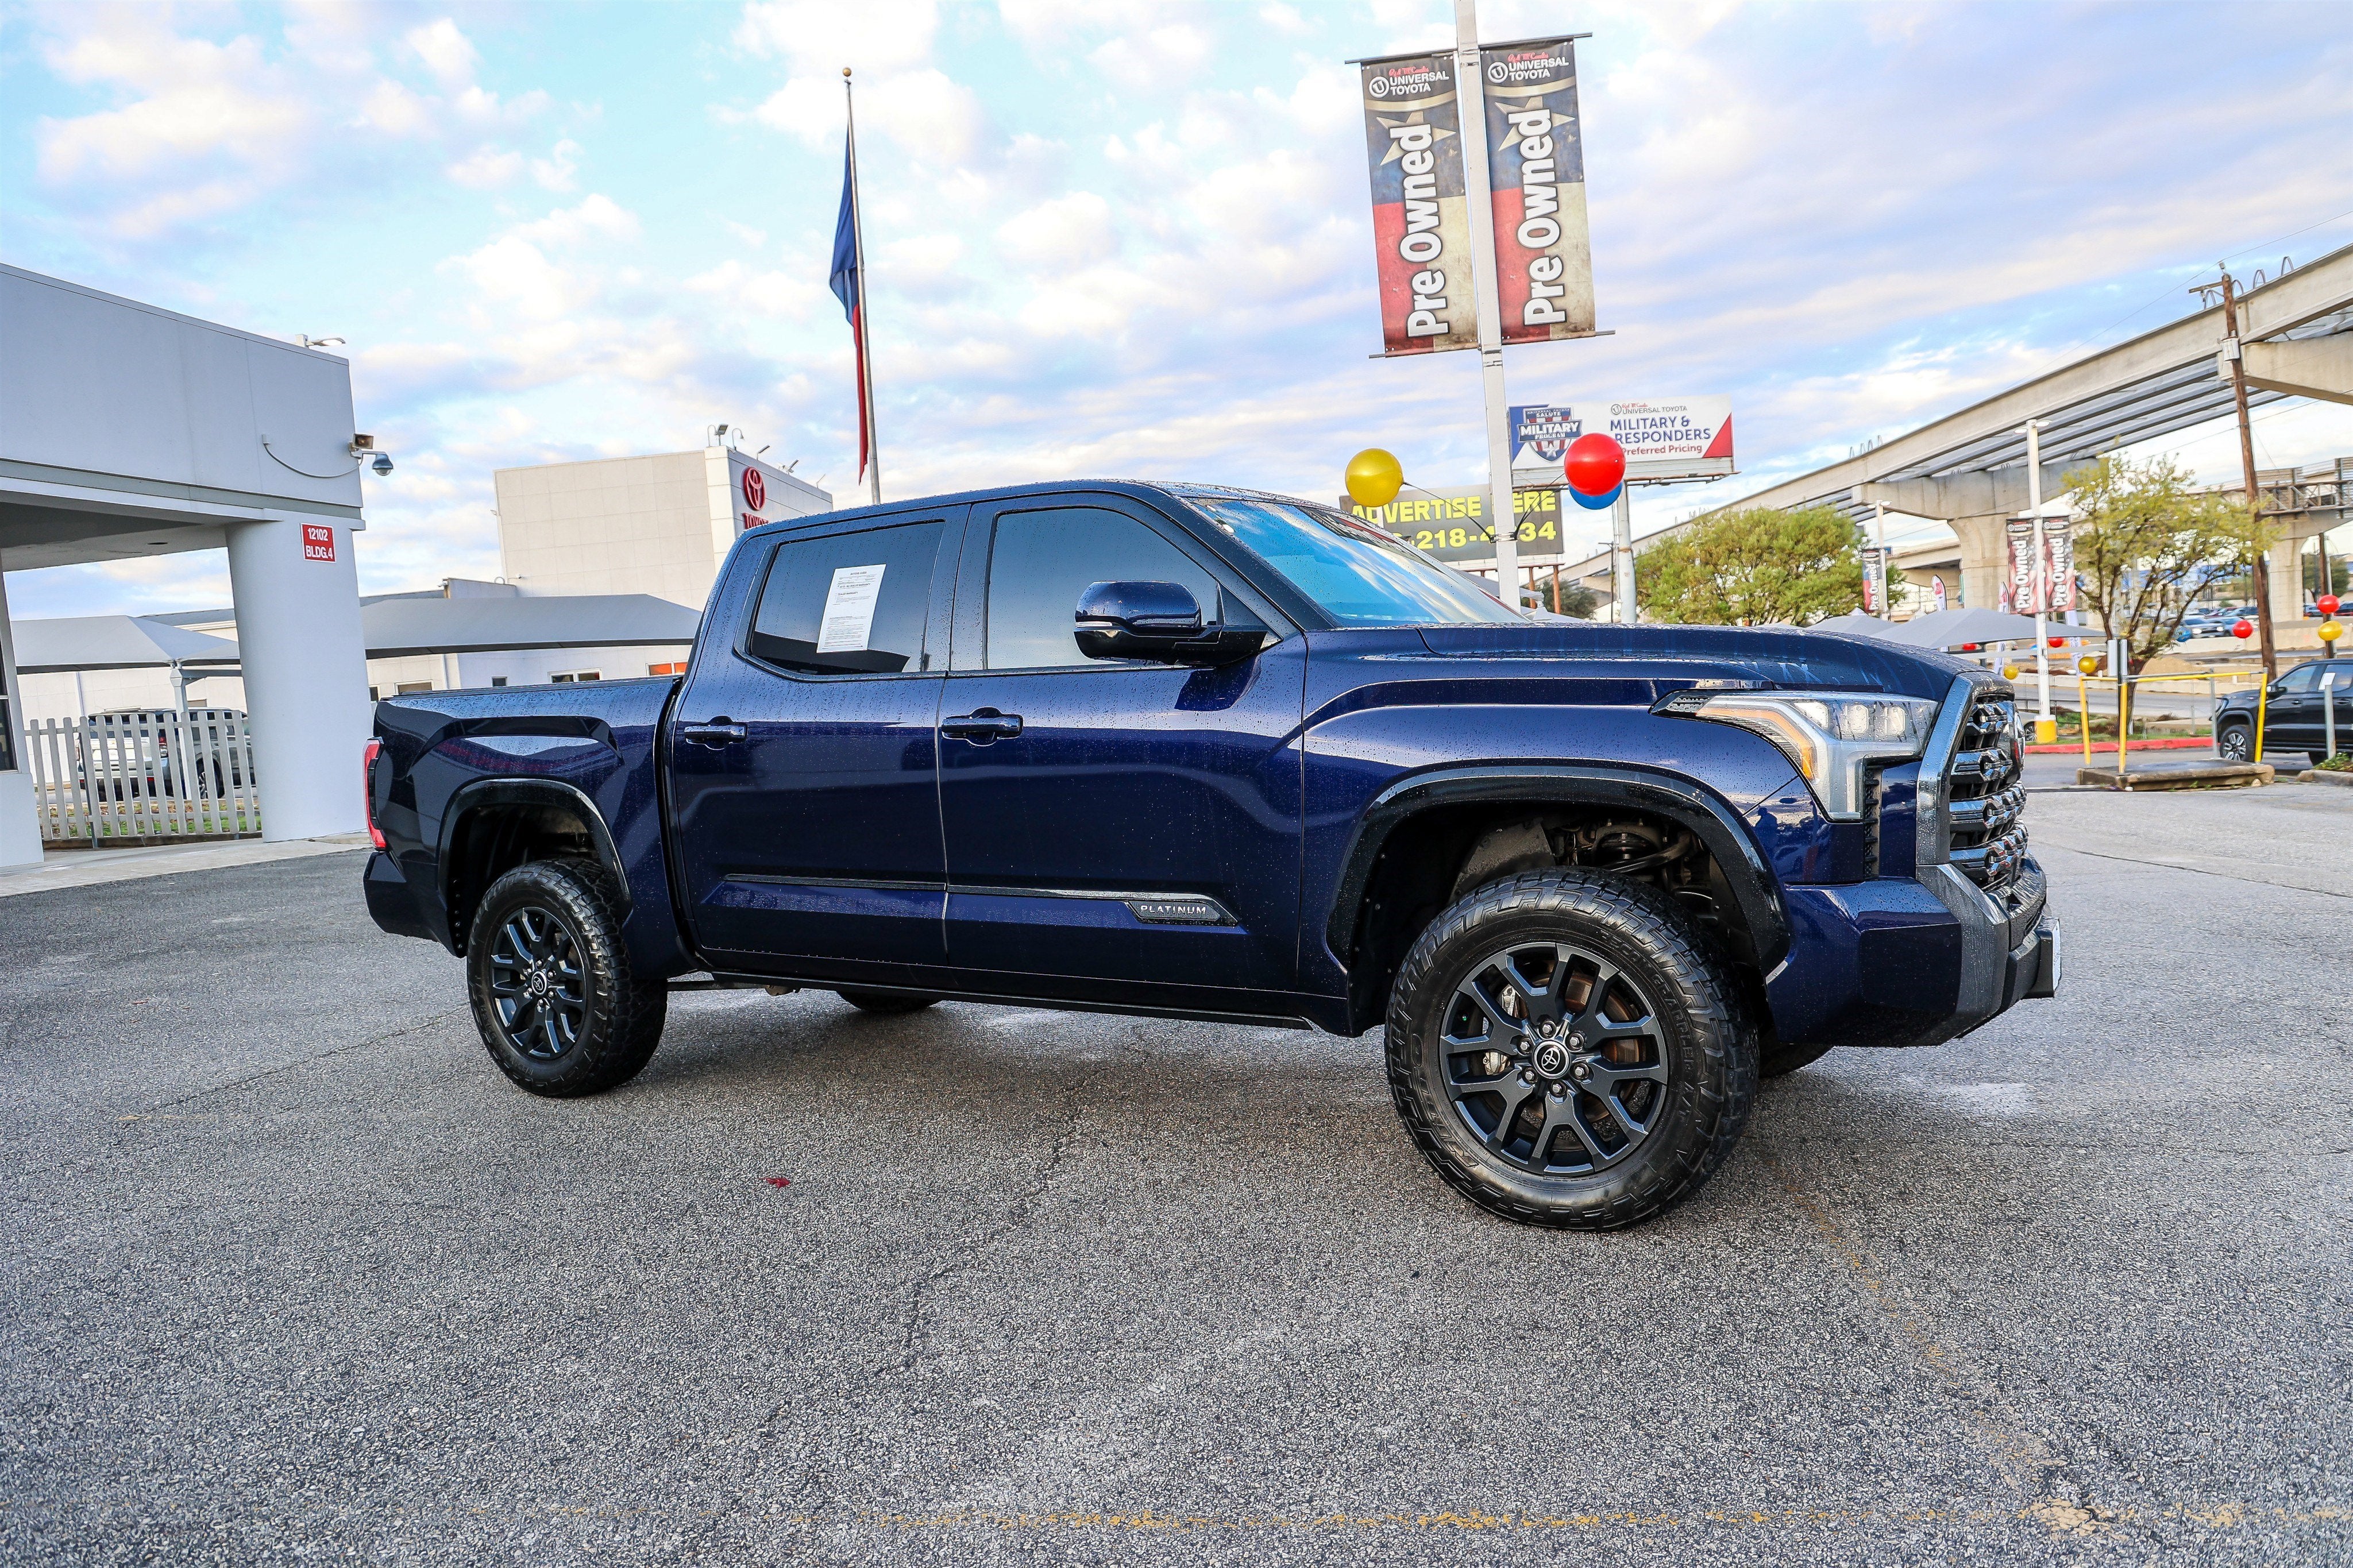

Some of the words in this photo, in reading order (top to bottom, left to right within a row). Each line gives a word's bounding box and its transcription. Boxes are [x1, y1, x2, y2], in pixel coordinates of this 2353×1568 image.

[1509, 56, 1569, 72] UNIVERSAL
[1390, 71, 1449, 86] UNIVERSAL
[1509, 69, 1550, 81] TOYOTA
[1390, 82, 1432, 96] TOYOTA
[1507, 109, 1561, 249] Owned
[1389, 123, 1442, 262] Owned
[1523, 256, 1565, 326] Pre
[1407, 269, 1450, 338] Pre
[1520, 422, 1580, 437] MILITARY
[1610, 415, 1678, 431] MILITARY
[1681, 415, 1691, 427] &
[1615, 428, 1711, 444] RESPONDERS
[1668, 443, 1702, 454] Pricing
[1352, 496, 1482, 524] ADVERTISE
[1491, 490, 1556, 515] ERE
[307, 527, 329, 541] 12102
[2012, 540, 2029, 585] Owned
[2049, 538, 2066, 583] Owned
[2015, 586, 2030, 609] Pre
[2052, 584, 2067, 607] Pre
[1140, 905, 1206, 914] PLATINUM
